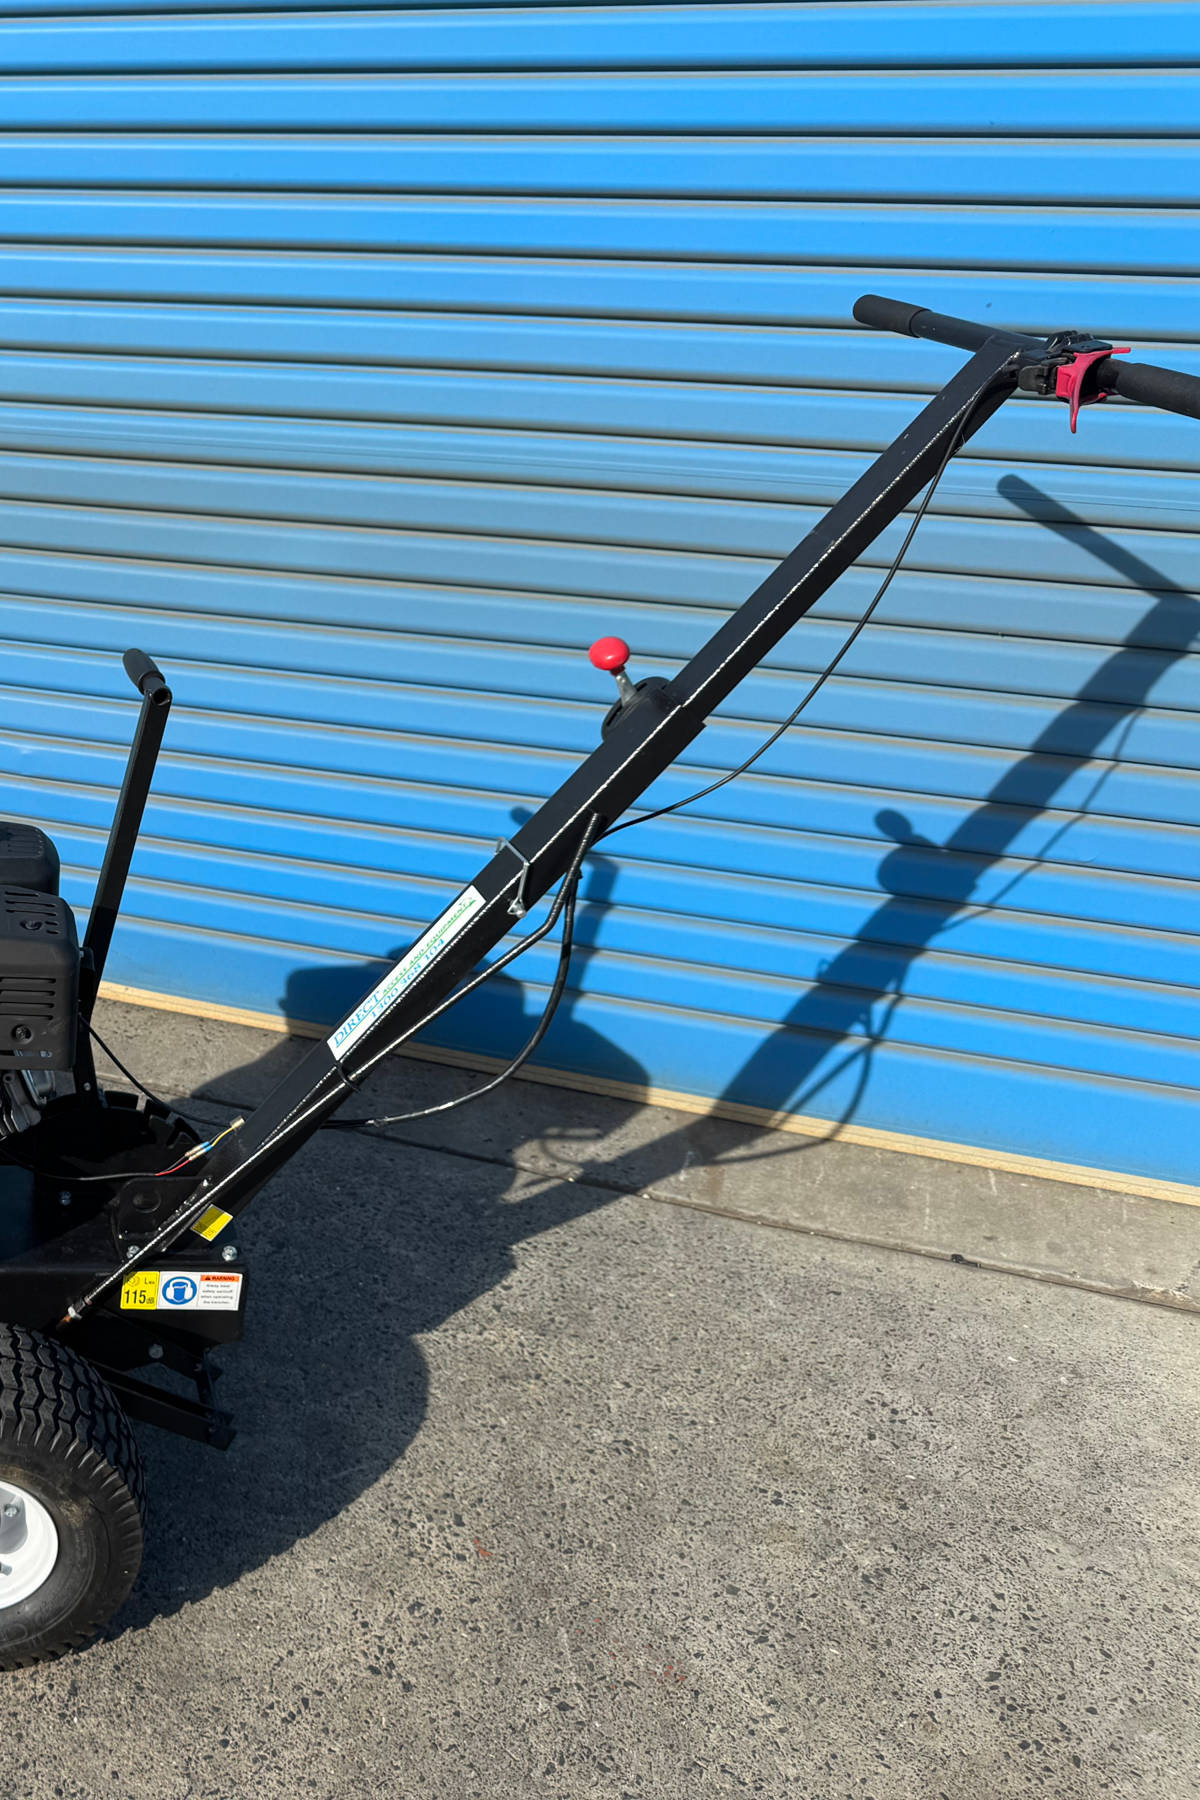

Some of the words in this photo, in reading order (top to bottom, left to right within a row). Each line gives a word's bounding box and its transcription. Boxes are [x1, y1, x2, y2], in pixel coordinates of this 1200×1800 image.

[333, 990, 384, 1046] DIRECT
[382, 967, 407, 995] ACCESS
[409, 947, 424, 966] AND
[426, 901, 467, 948] EQUIPMENT
[371, 987, 399, 1019] 1300
[400, 963, 422, 987] 368
[425, 938, 445, 961] 104
[124, 1289, 146, 1304] 115
